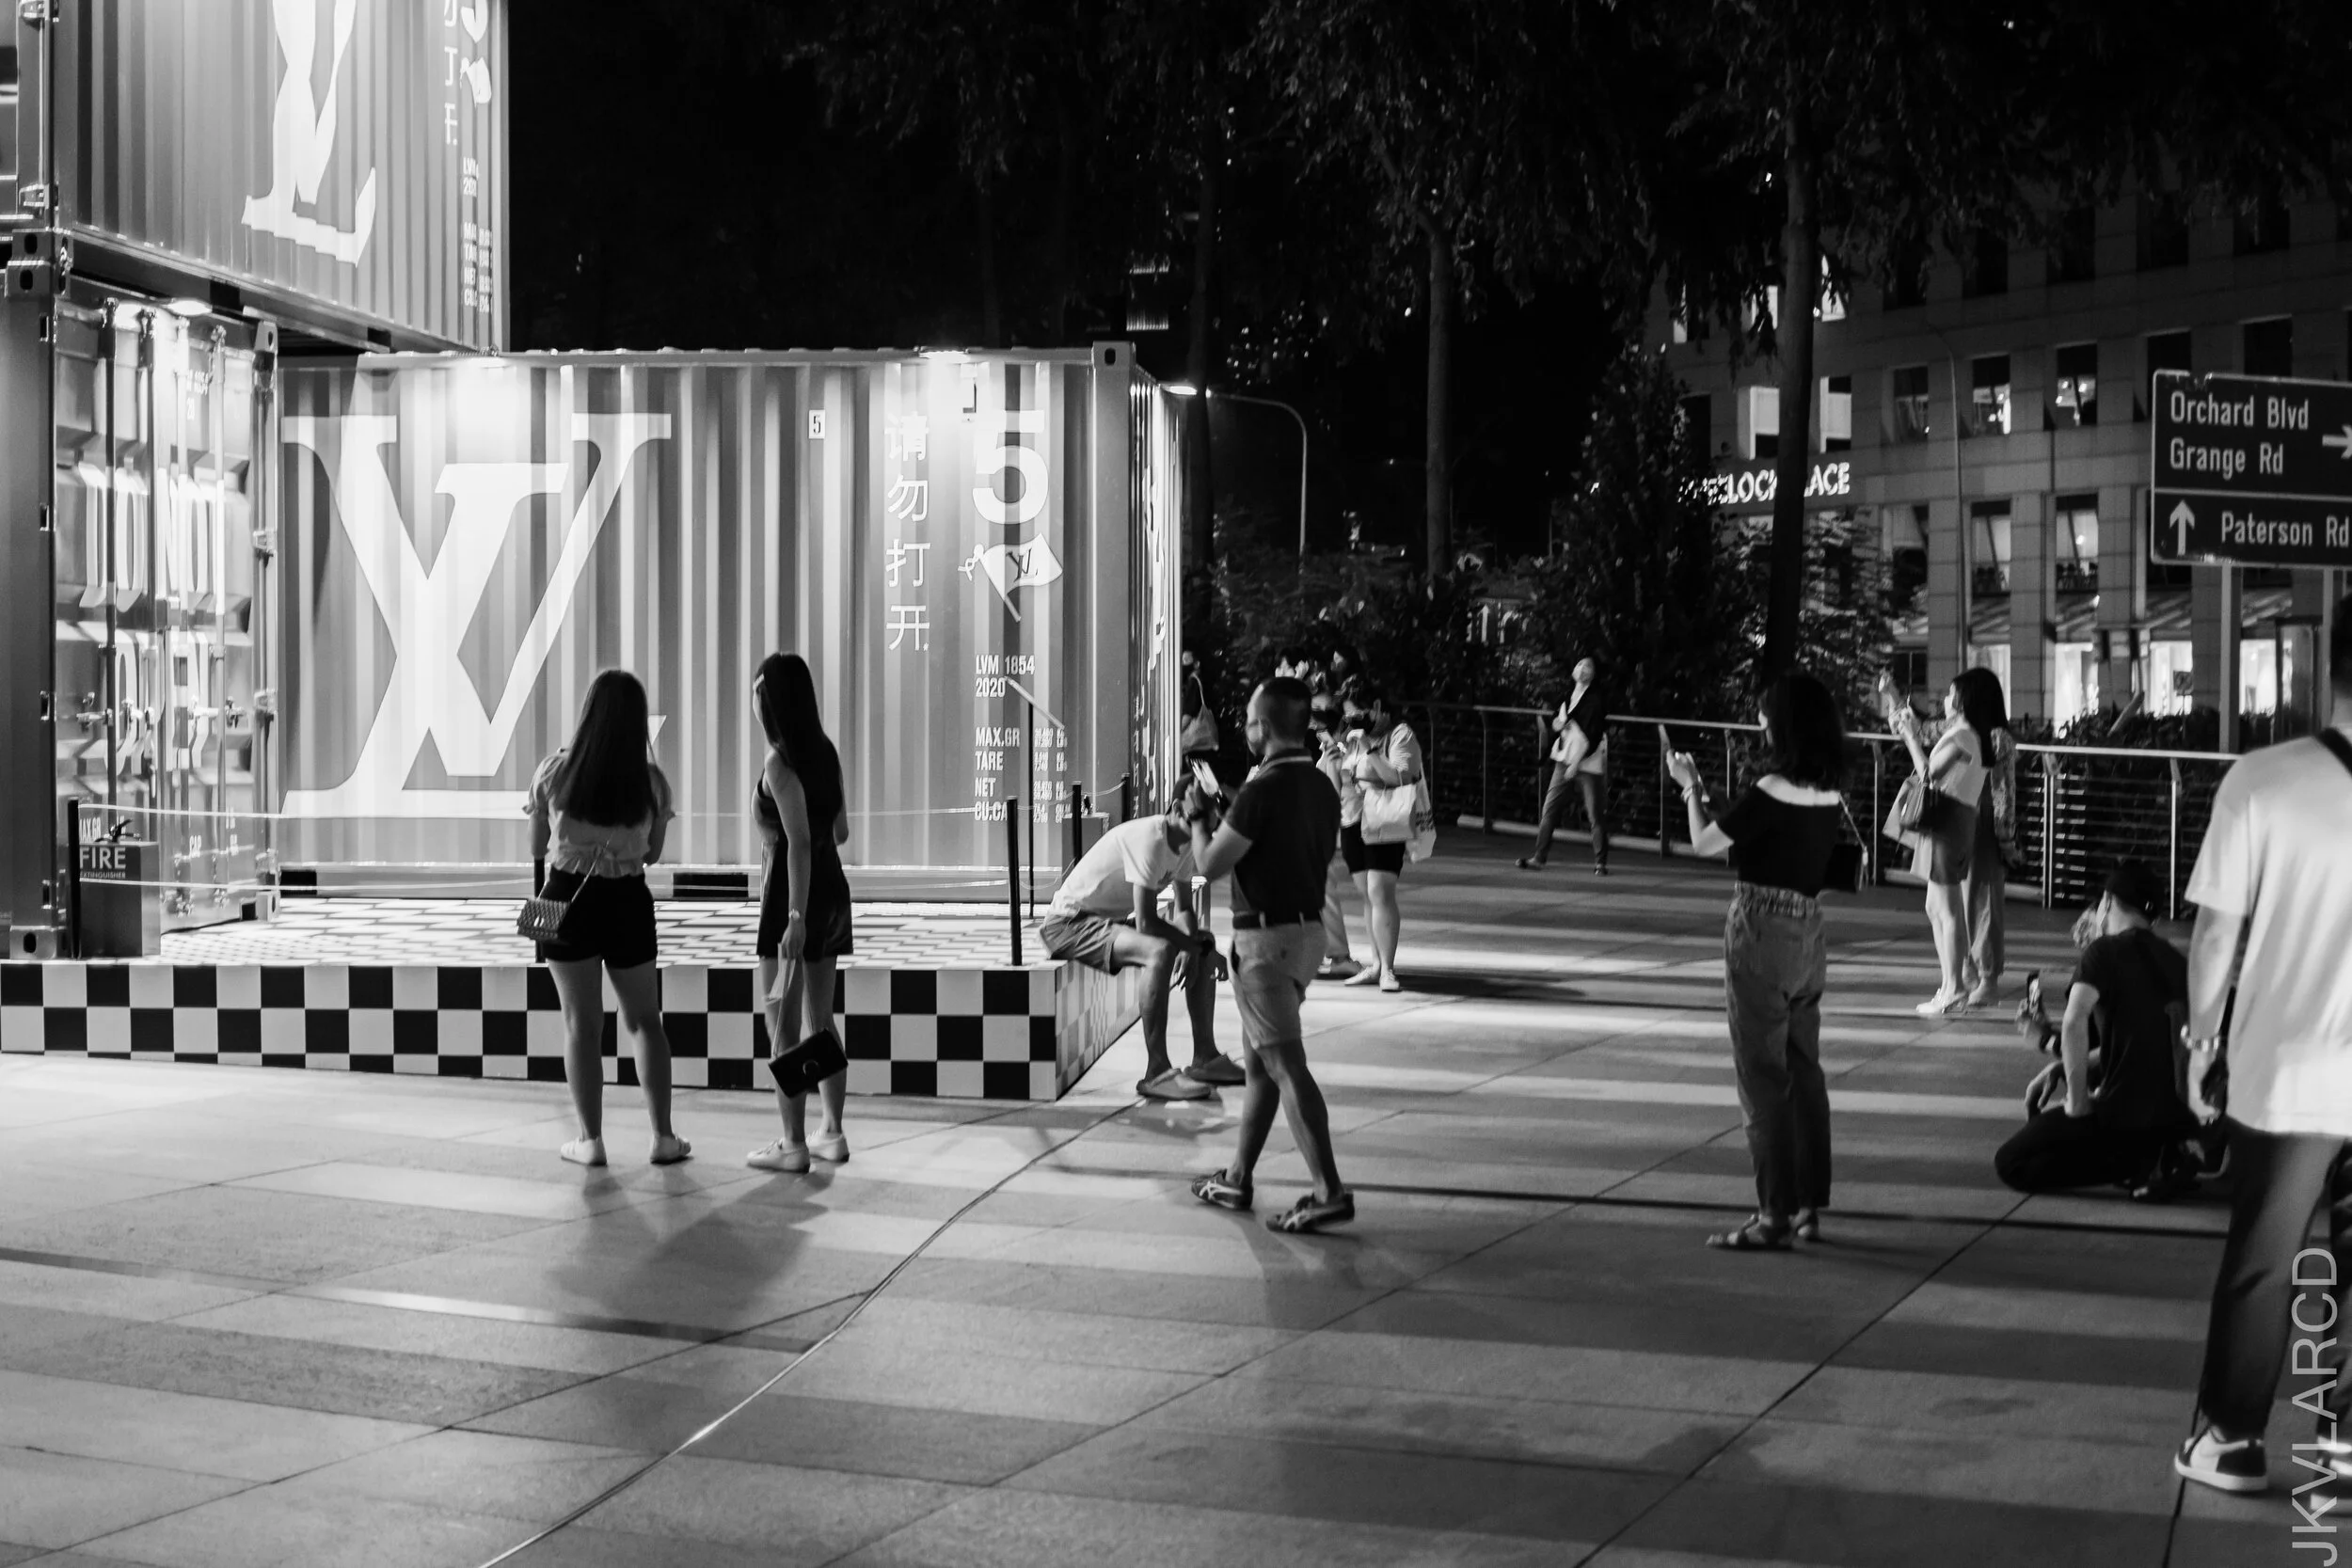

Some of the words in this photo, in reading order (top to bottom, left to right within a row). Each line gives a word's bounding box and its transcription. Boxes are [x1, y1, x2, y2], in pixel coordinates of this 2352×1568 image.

[2170, 390, 2254, 427] Orchard
[2267, 396, 2310, 430] Blvd
[972, 409, 1049, 525] 5
[2170, 437, 2247, 481] Grange
[2260, 441, 2284, 475] Rd
[1804, 461, 1851, 498] ACE
[2221, 511, 2313, 546] Paterson
[2326, 515, 2351, 548] Rd
[976, 655, 999, 675] LVM
[1005, 655, 1036, 675] 1854
[976, 677, 1007, 698] 2020
[975, 751, 1004, 771] TARE
[975, 777, 996, 798] NET
[974, 801, 1008, 821] CU.CA
[79, 847, 127, 869] FIRE
